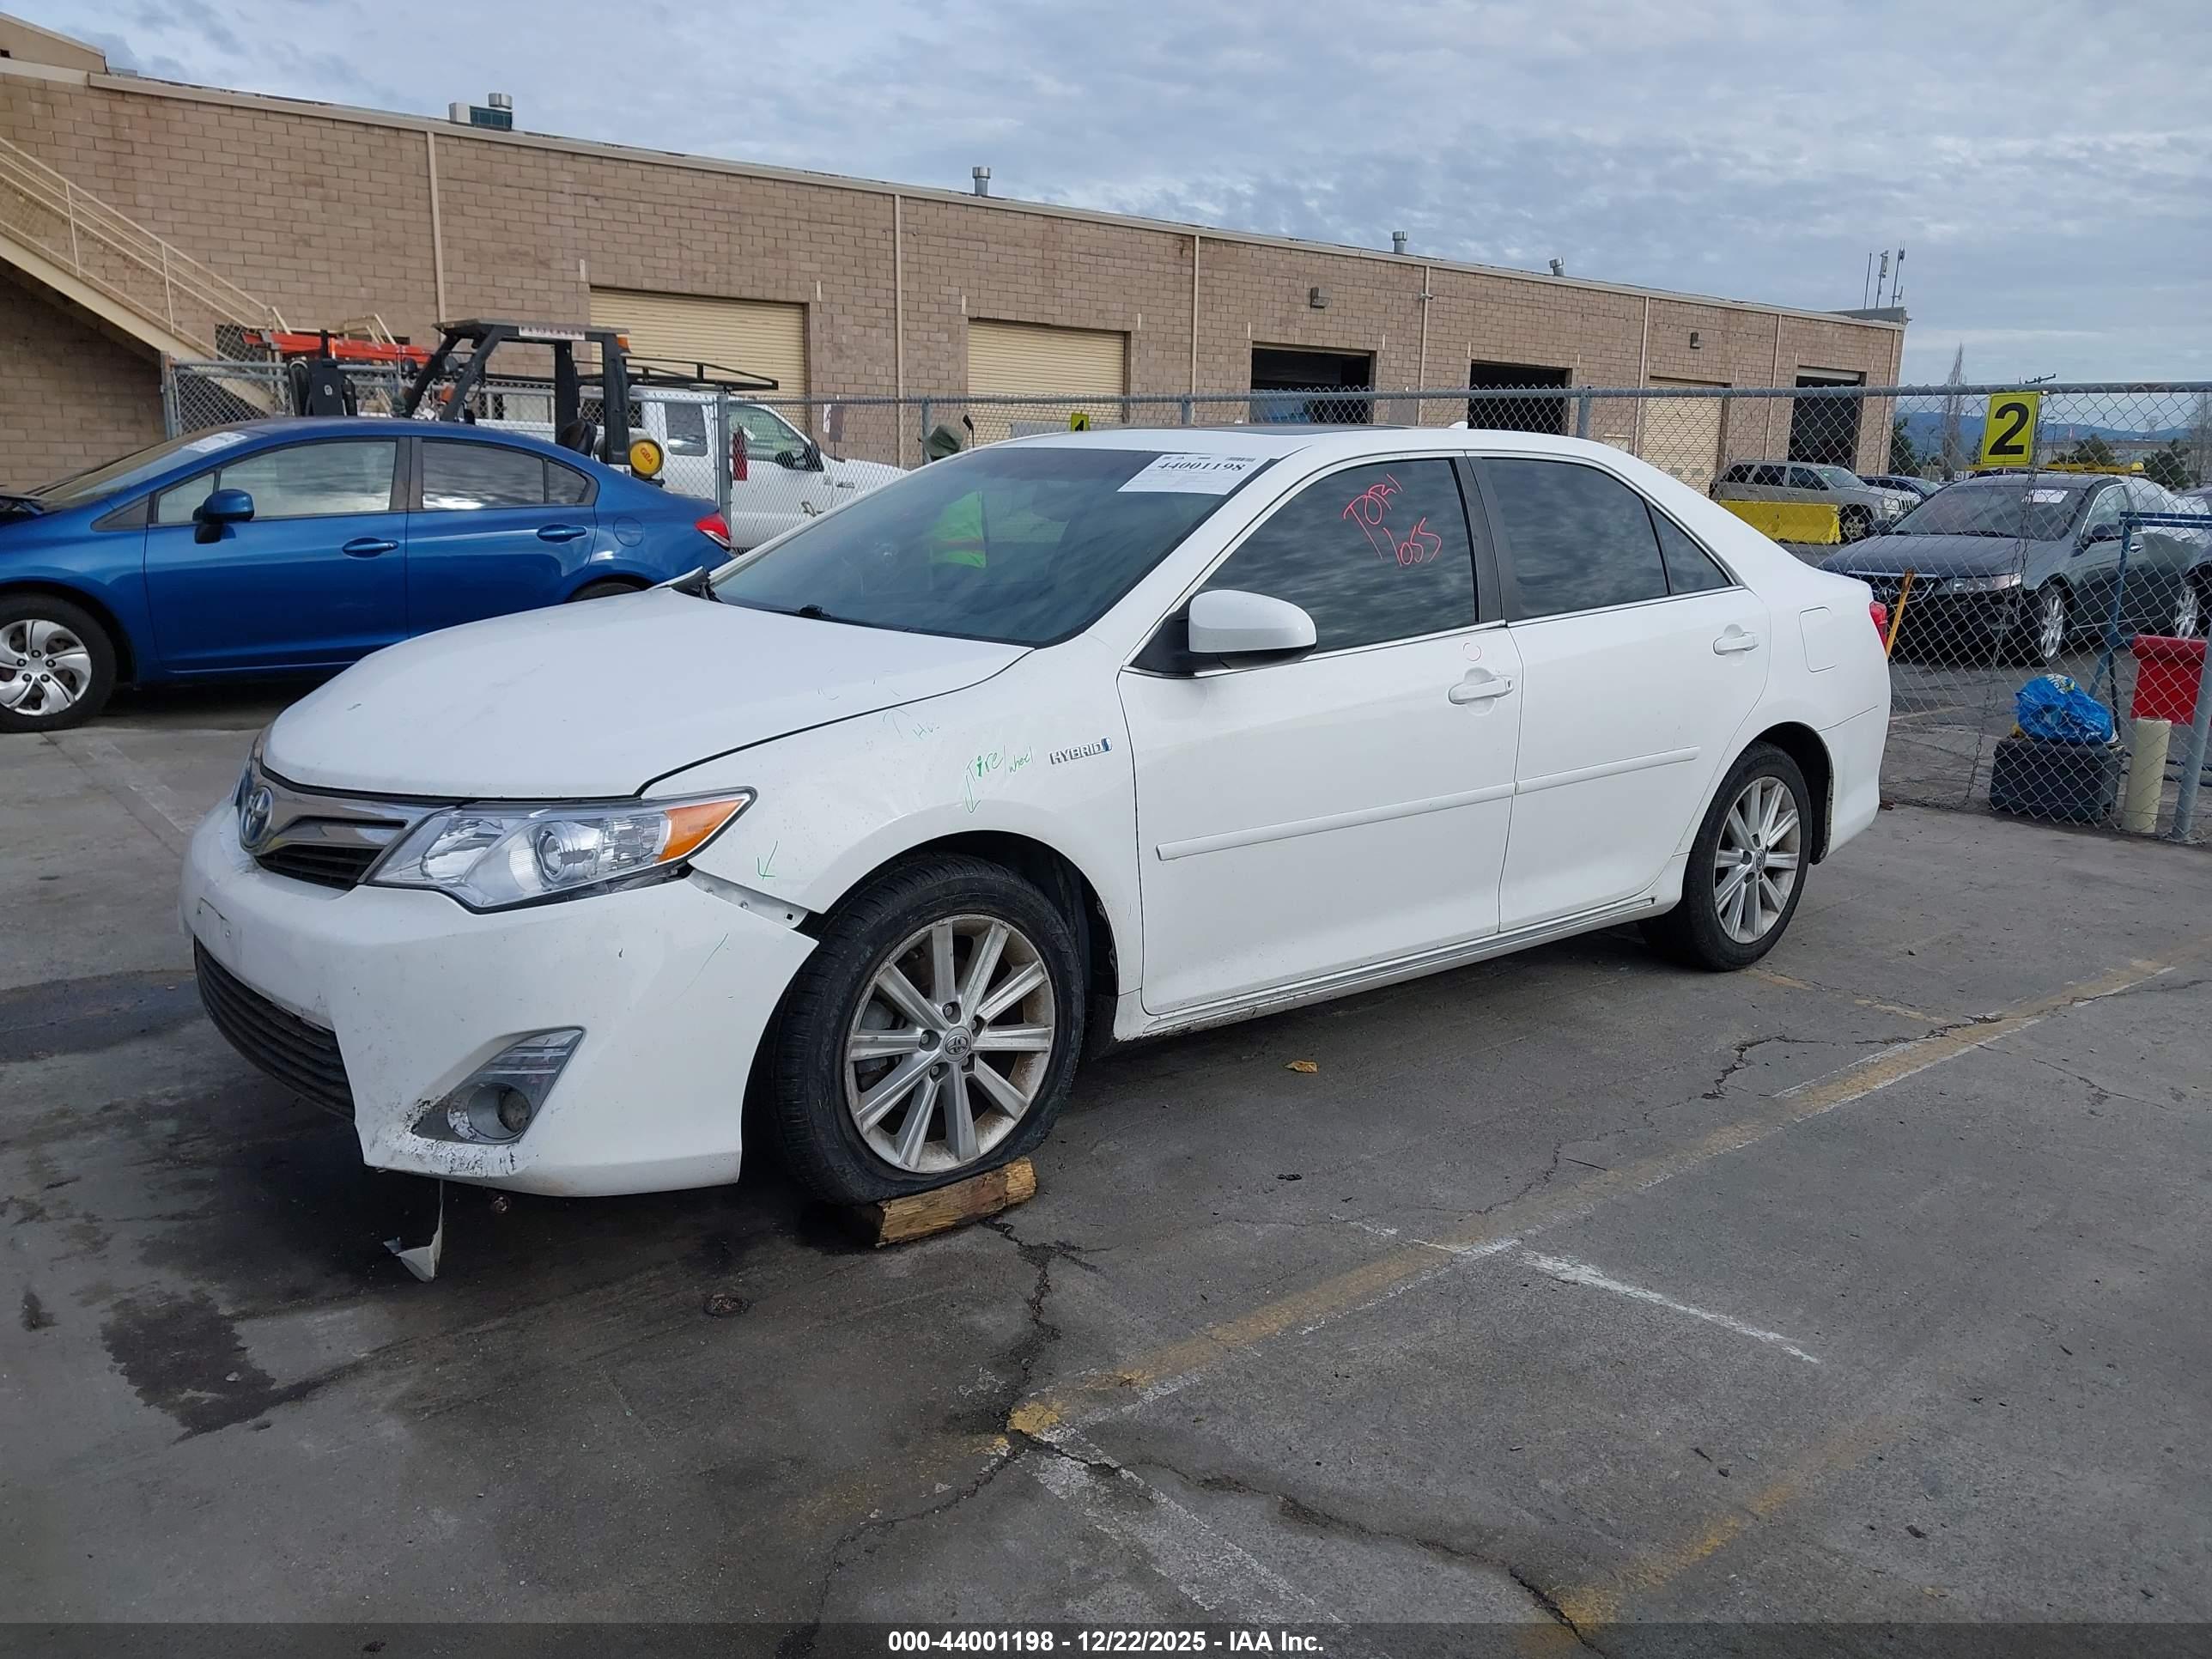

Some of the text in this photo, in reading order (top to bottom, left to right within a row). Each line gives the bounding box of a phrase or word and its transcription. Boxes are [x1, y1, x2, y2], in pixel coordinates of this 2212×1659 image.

[1989, 403, 2029, 455] 2
[1158, 461, 1246, 471] 44001198
[1049, 742, 1104, 764] HYBRID
